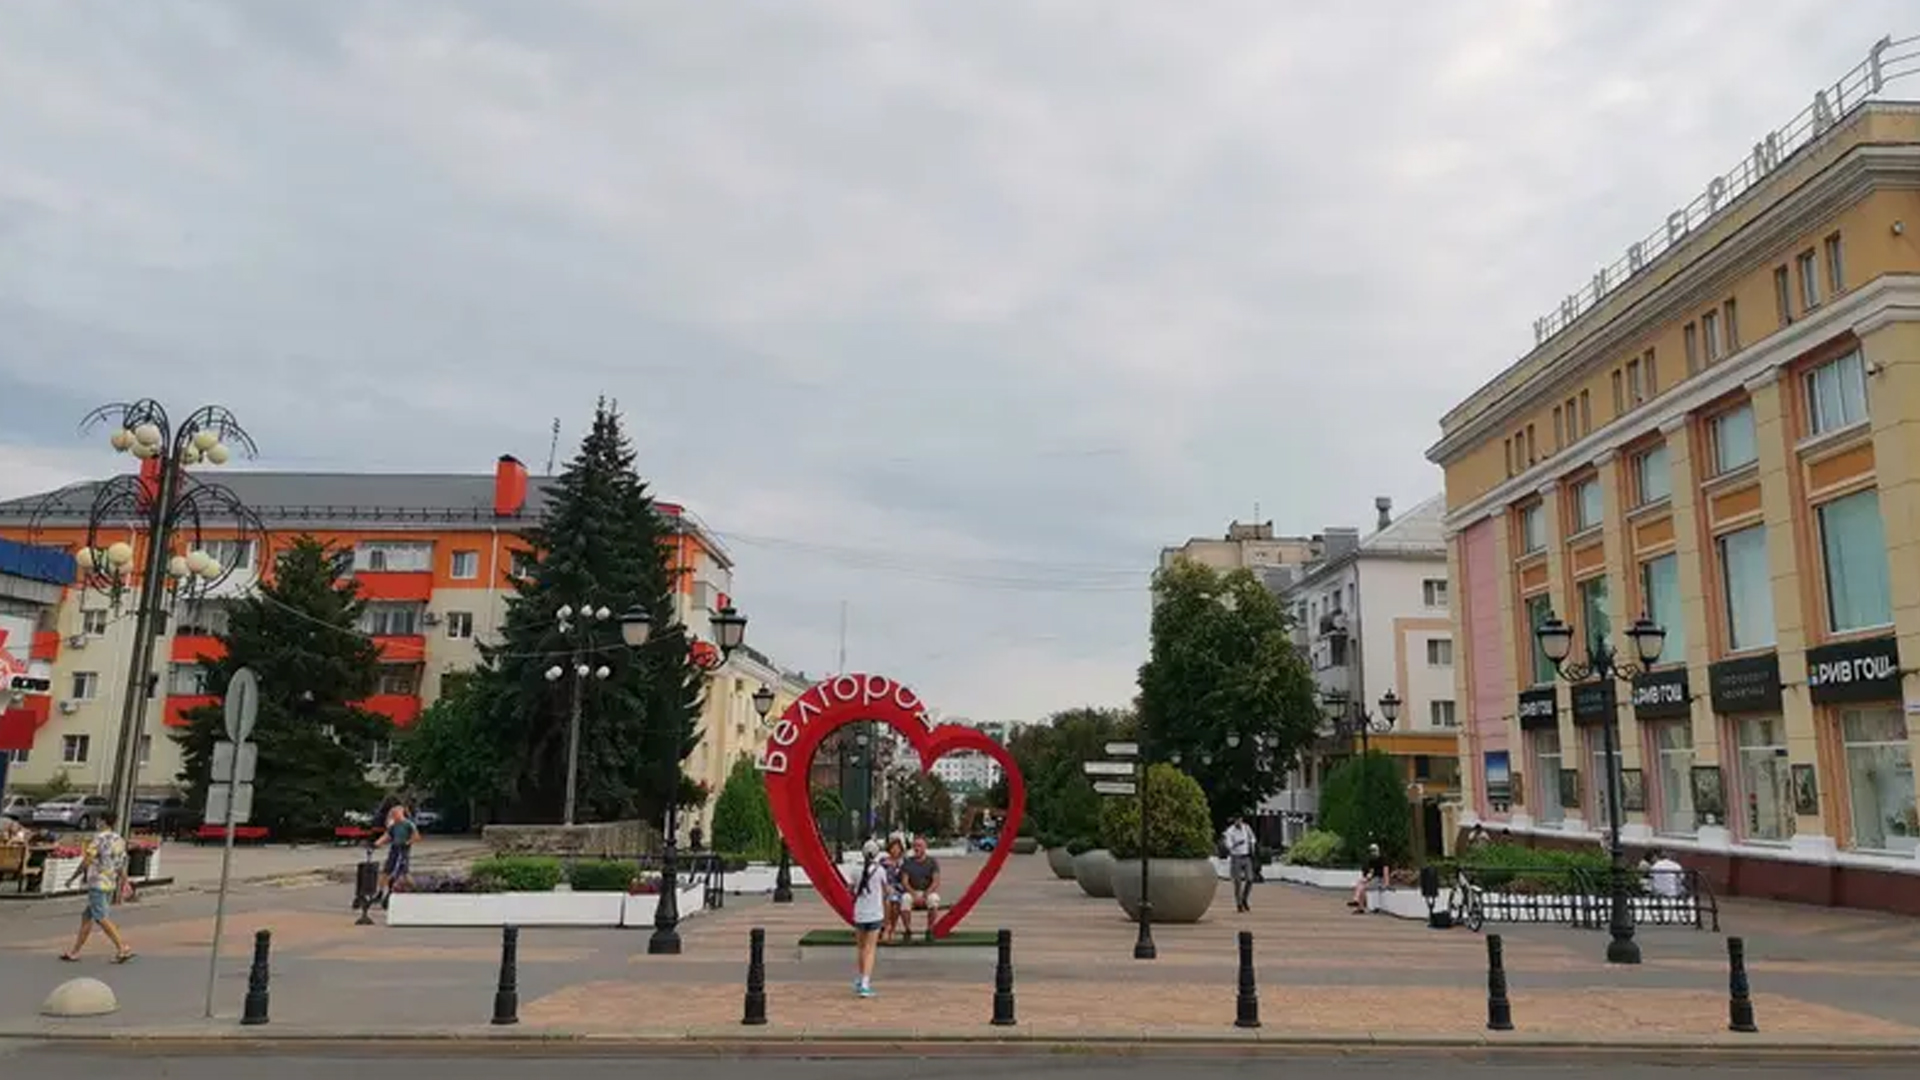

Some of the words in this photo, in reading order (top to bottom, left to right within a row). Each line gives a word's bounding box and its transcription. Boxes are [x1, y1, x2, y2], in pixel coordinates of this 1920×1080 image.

[1533, 34, 1890, 346] УНИВЕРМАГ
[1819, 660, 1852, 684] РИВ
[1854, 655, 1897, 680] ГОШ
